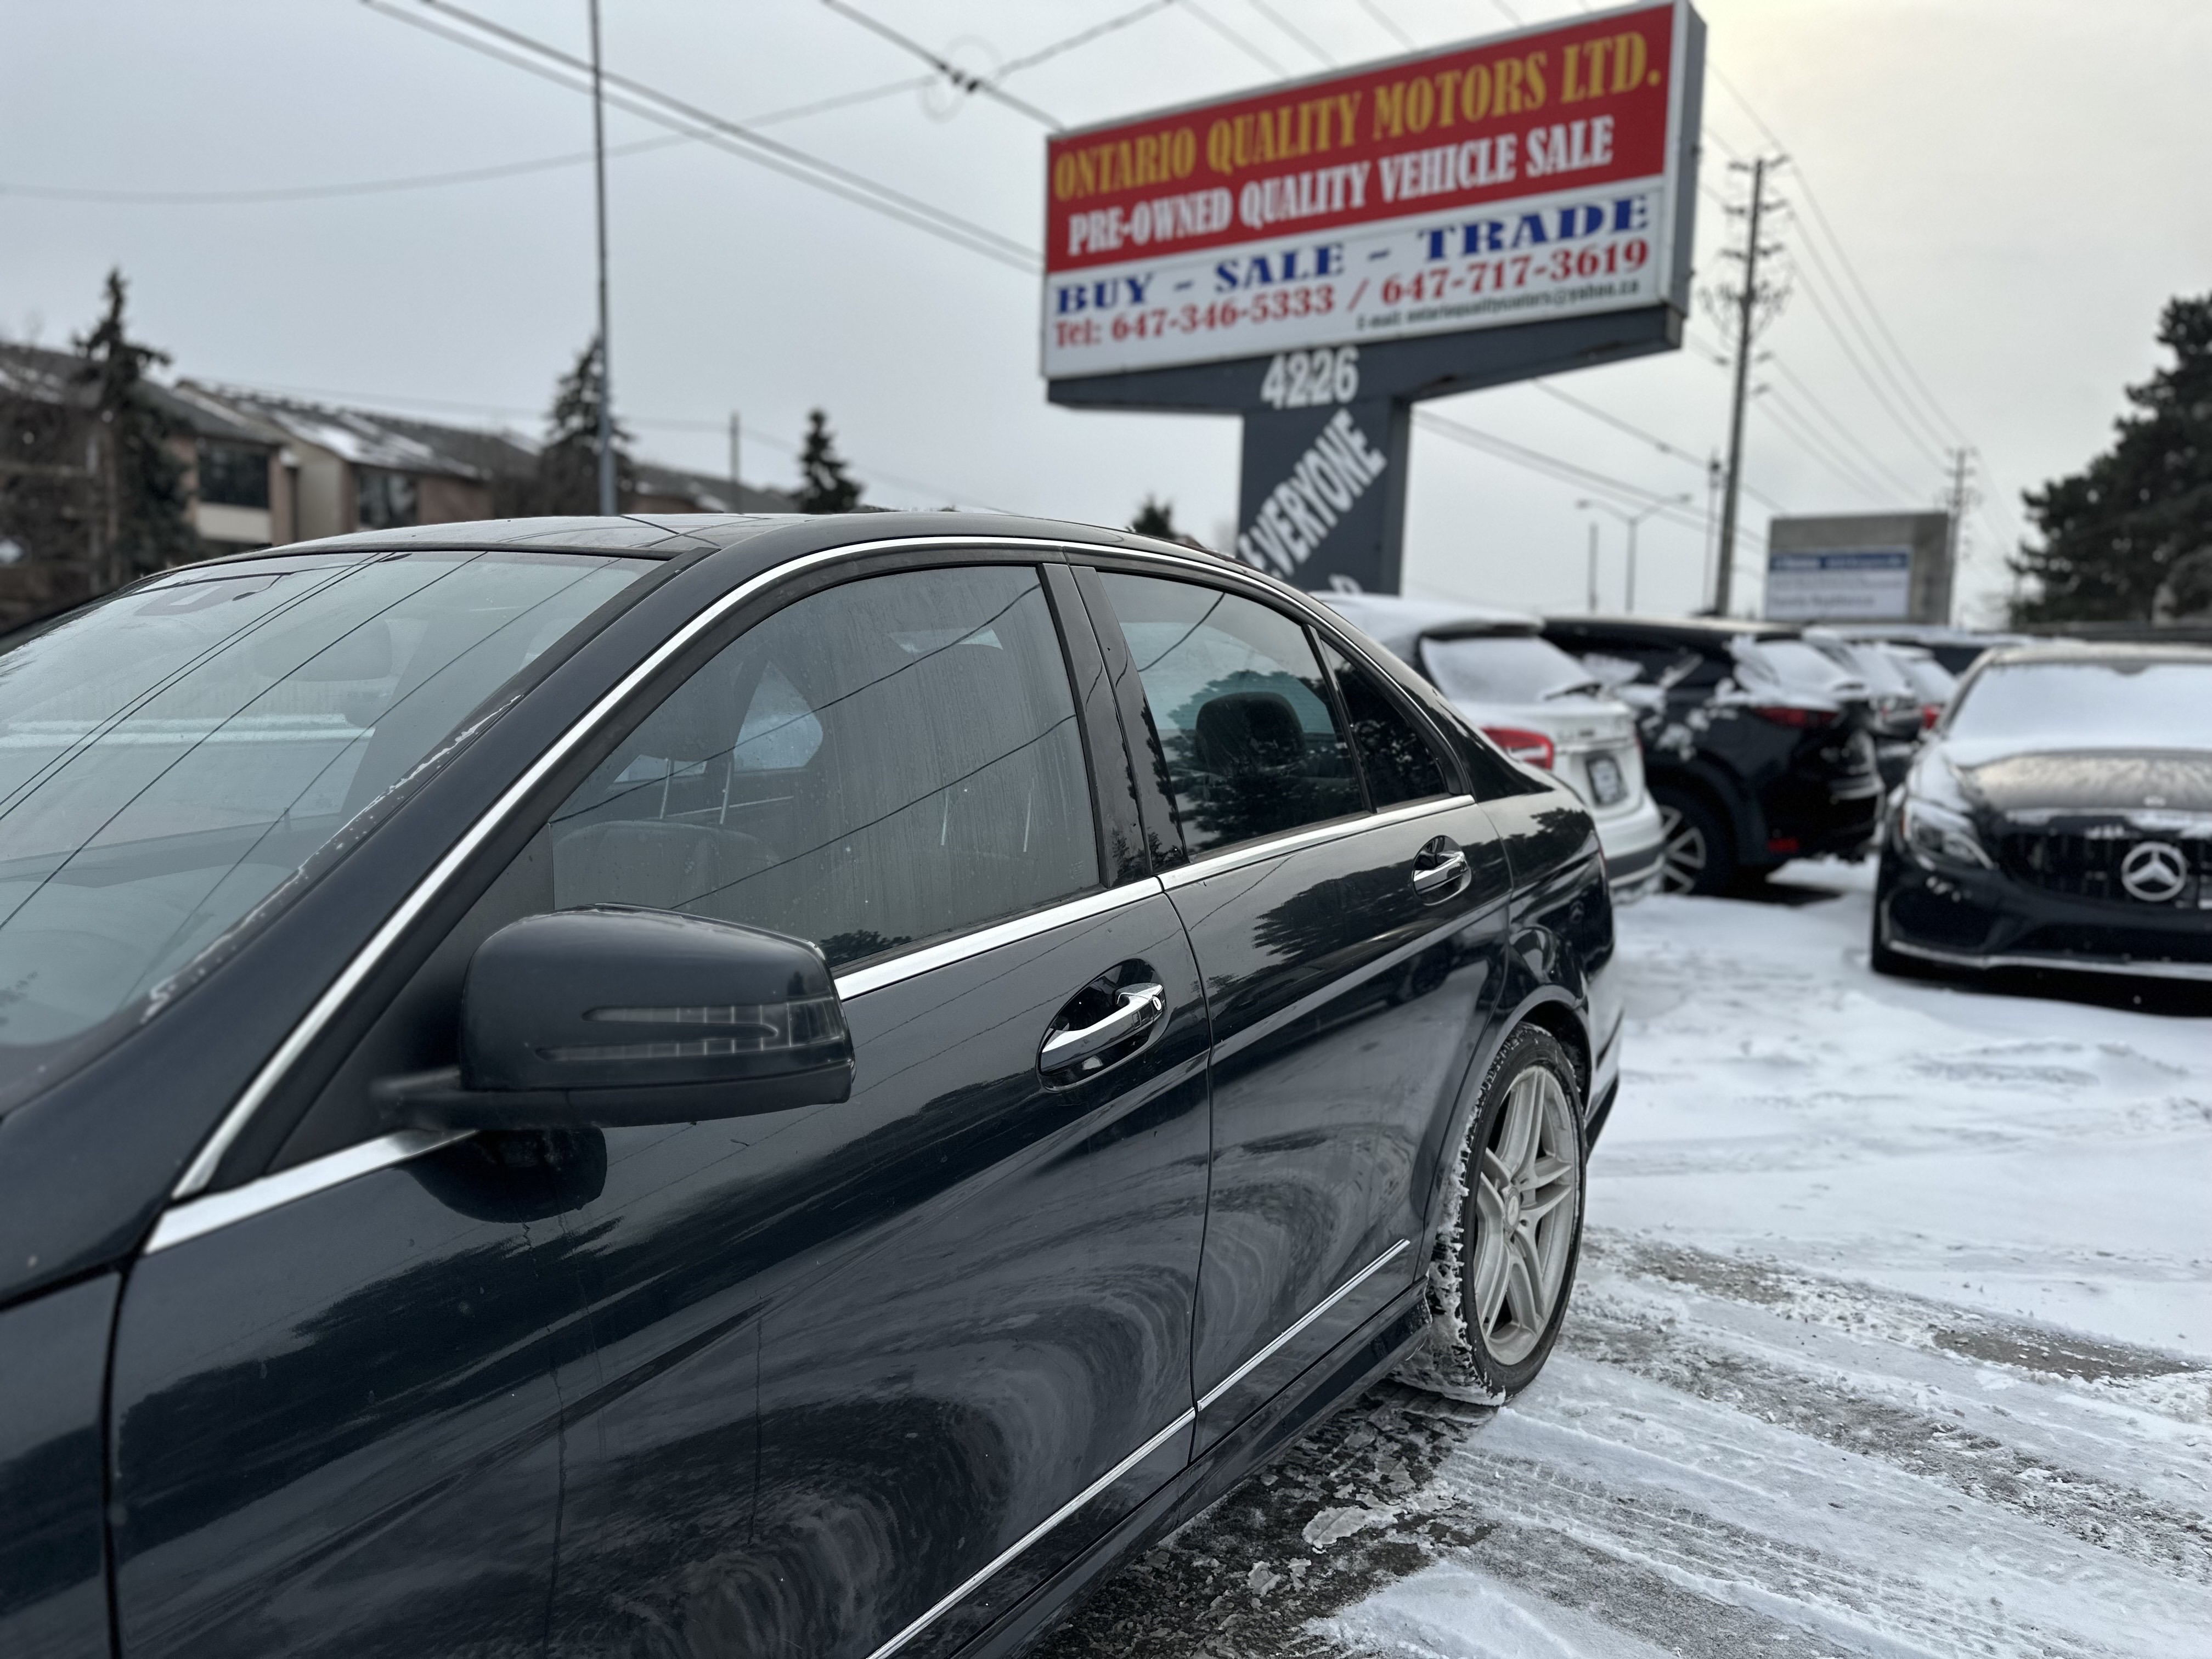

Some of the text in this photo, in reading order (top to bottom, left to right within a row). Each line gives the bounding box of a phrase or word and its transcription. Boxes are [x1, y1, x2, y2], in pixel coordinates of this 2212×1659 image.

[1054, 31, 1661, 201] ONTARIO QUALITY MOTORS LTD.
[1068, 114, 1614, 256] PRE-OWNED QUALITY VEHICLE SALE
[1057, 273, 1153, 315] BUY
[1214, 242, 1344, 293] SALE
[1418, 193, 1649, 262] TRADE
[1057, 238, 1650, 348] Tel: 647-346-5333 / 647-717-3619
[1260, 346, 1359, 410] 4226
